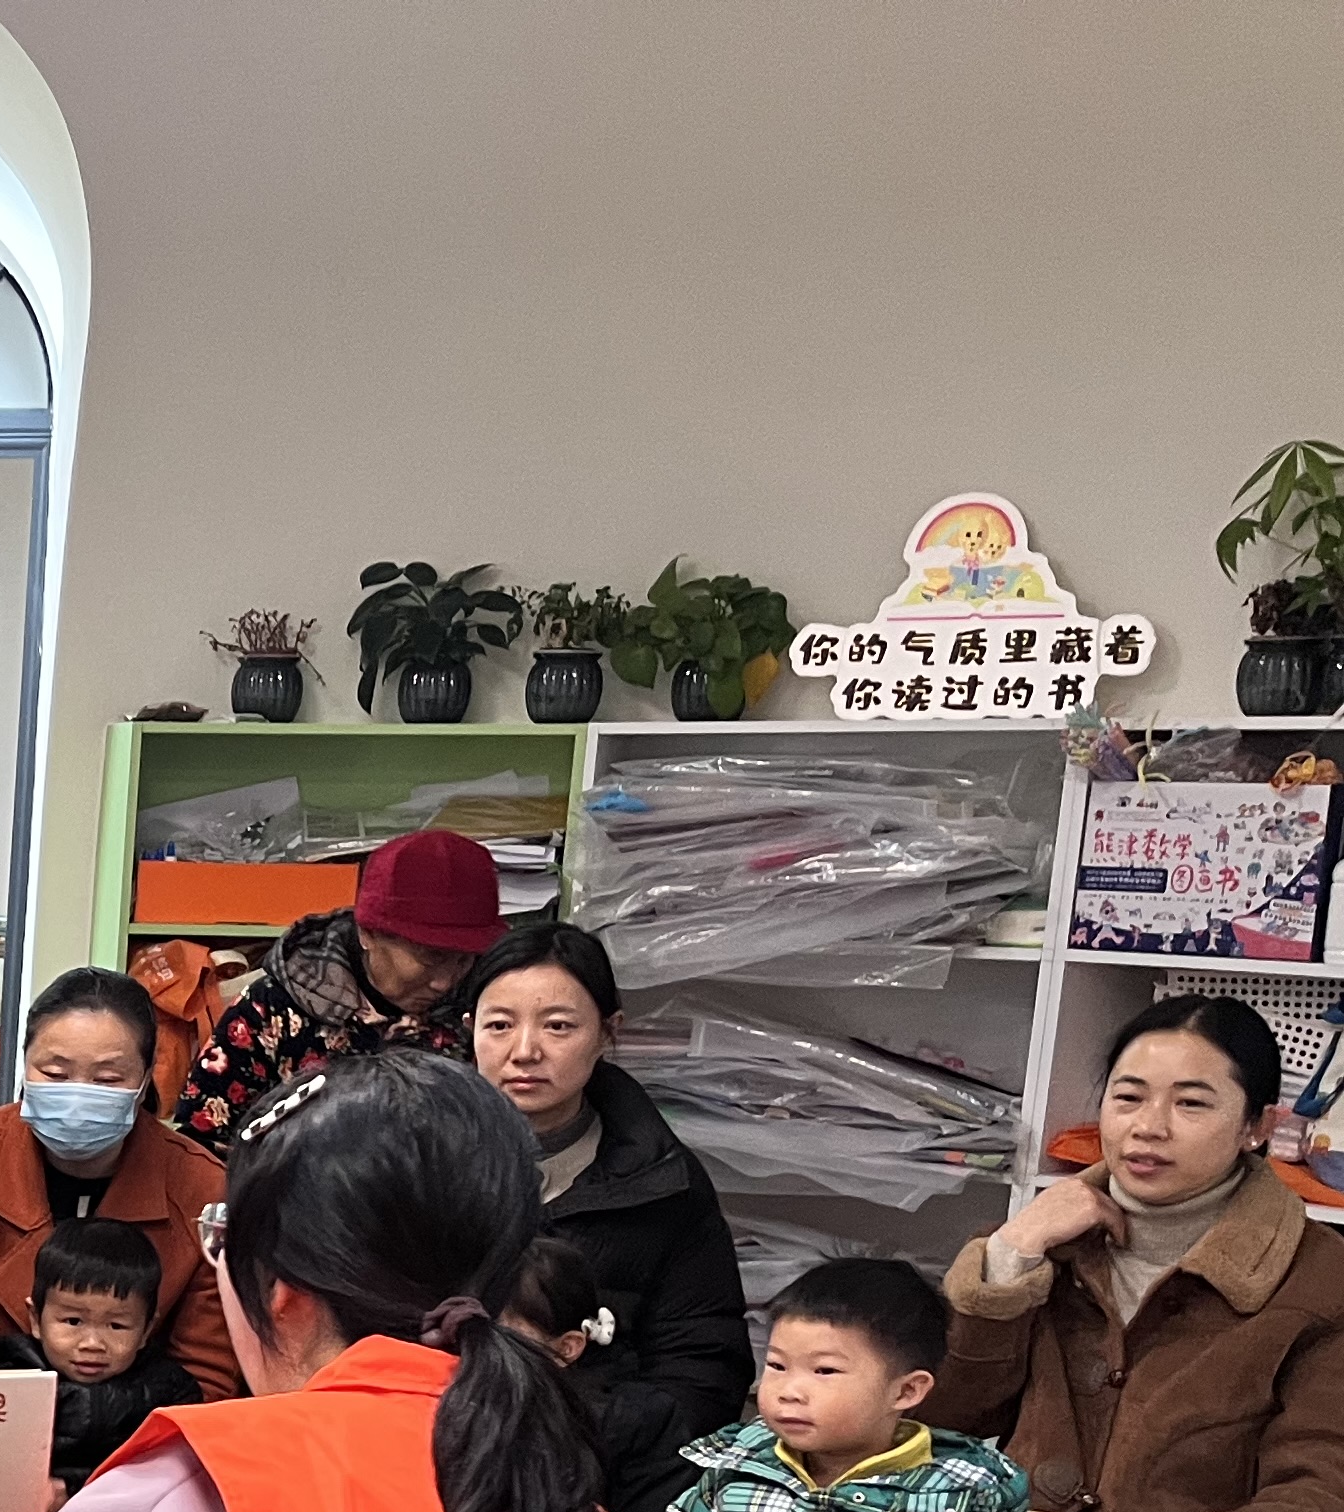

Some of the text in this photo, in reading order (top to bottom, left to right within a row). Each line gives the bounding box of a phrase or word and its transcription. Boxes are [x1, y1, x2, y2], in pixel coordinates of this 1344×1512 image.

[799, 625, 1145, 666] 你的气质里藏着
[842, 674, 1086, 712] 你读过的书
[1170, 864, 1241, 897] 图画书
